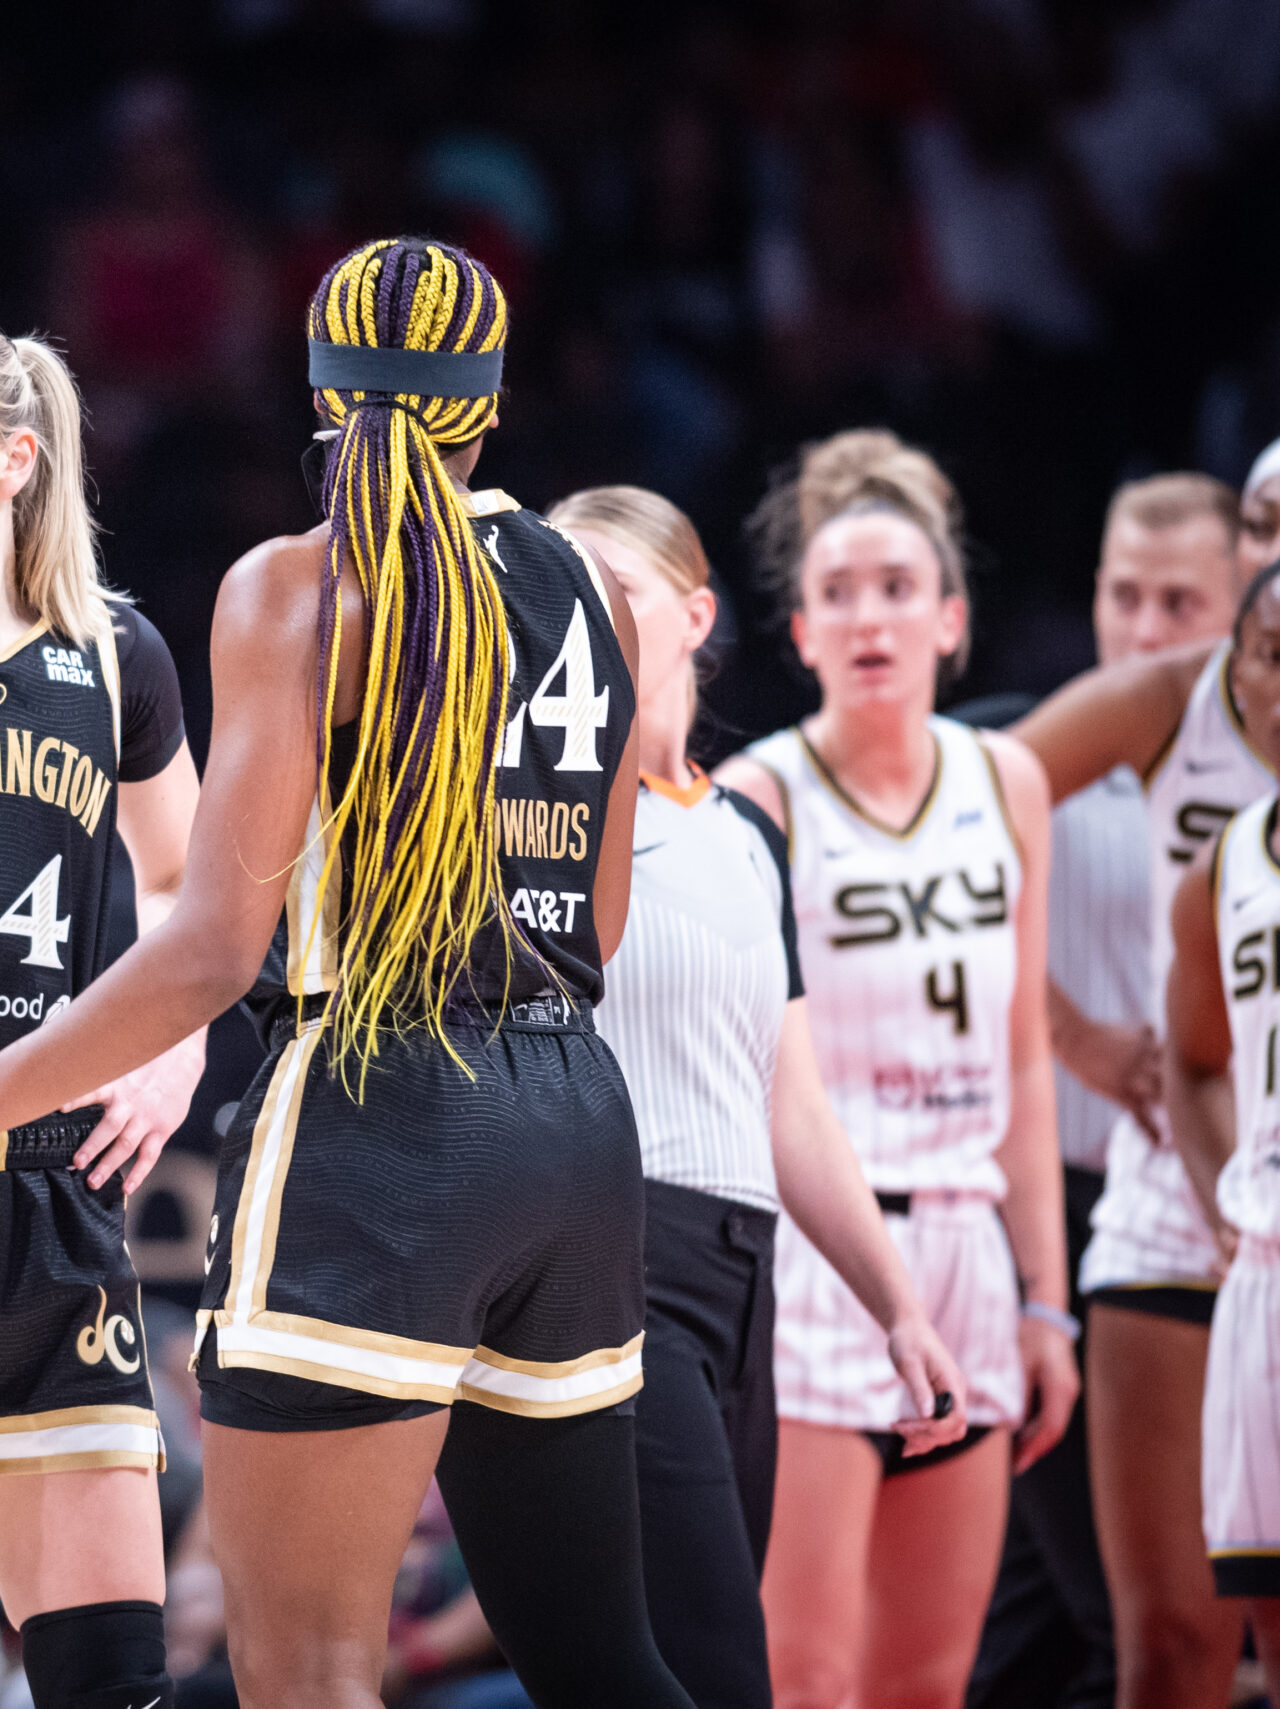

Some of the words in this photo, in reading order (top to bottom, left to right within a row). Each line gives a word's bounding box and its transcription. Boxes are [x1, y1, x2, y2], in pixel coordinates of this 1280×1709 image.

[42, 646, 83, 668] CAR
[47, 664, 95, 687] max
[495, 597, 609, 771] 4
[494, 798, 590, 861] WARDS
[830, 862, 1007, 948] SKY
[926, 960, 969, 1036] 4
